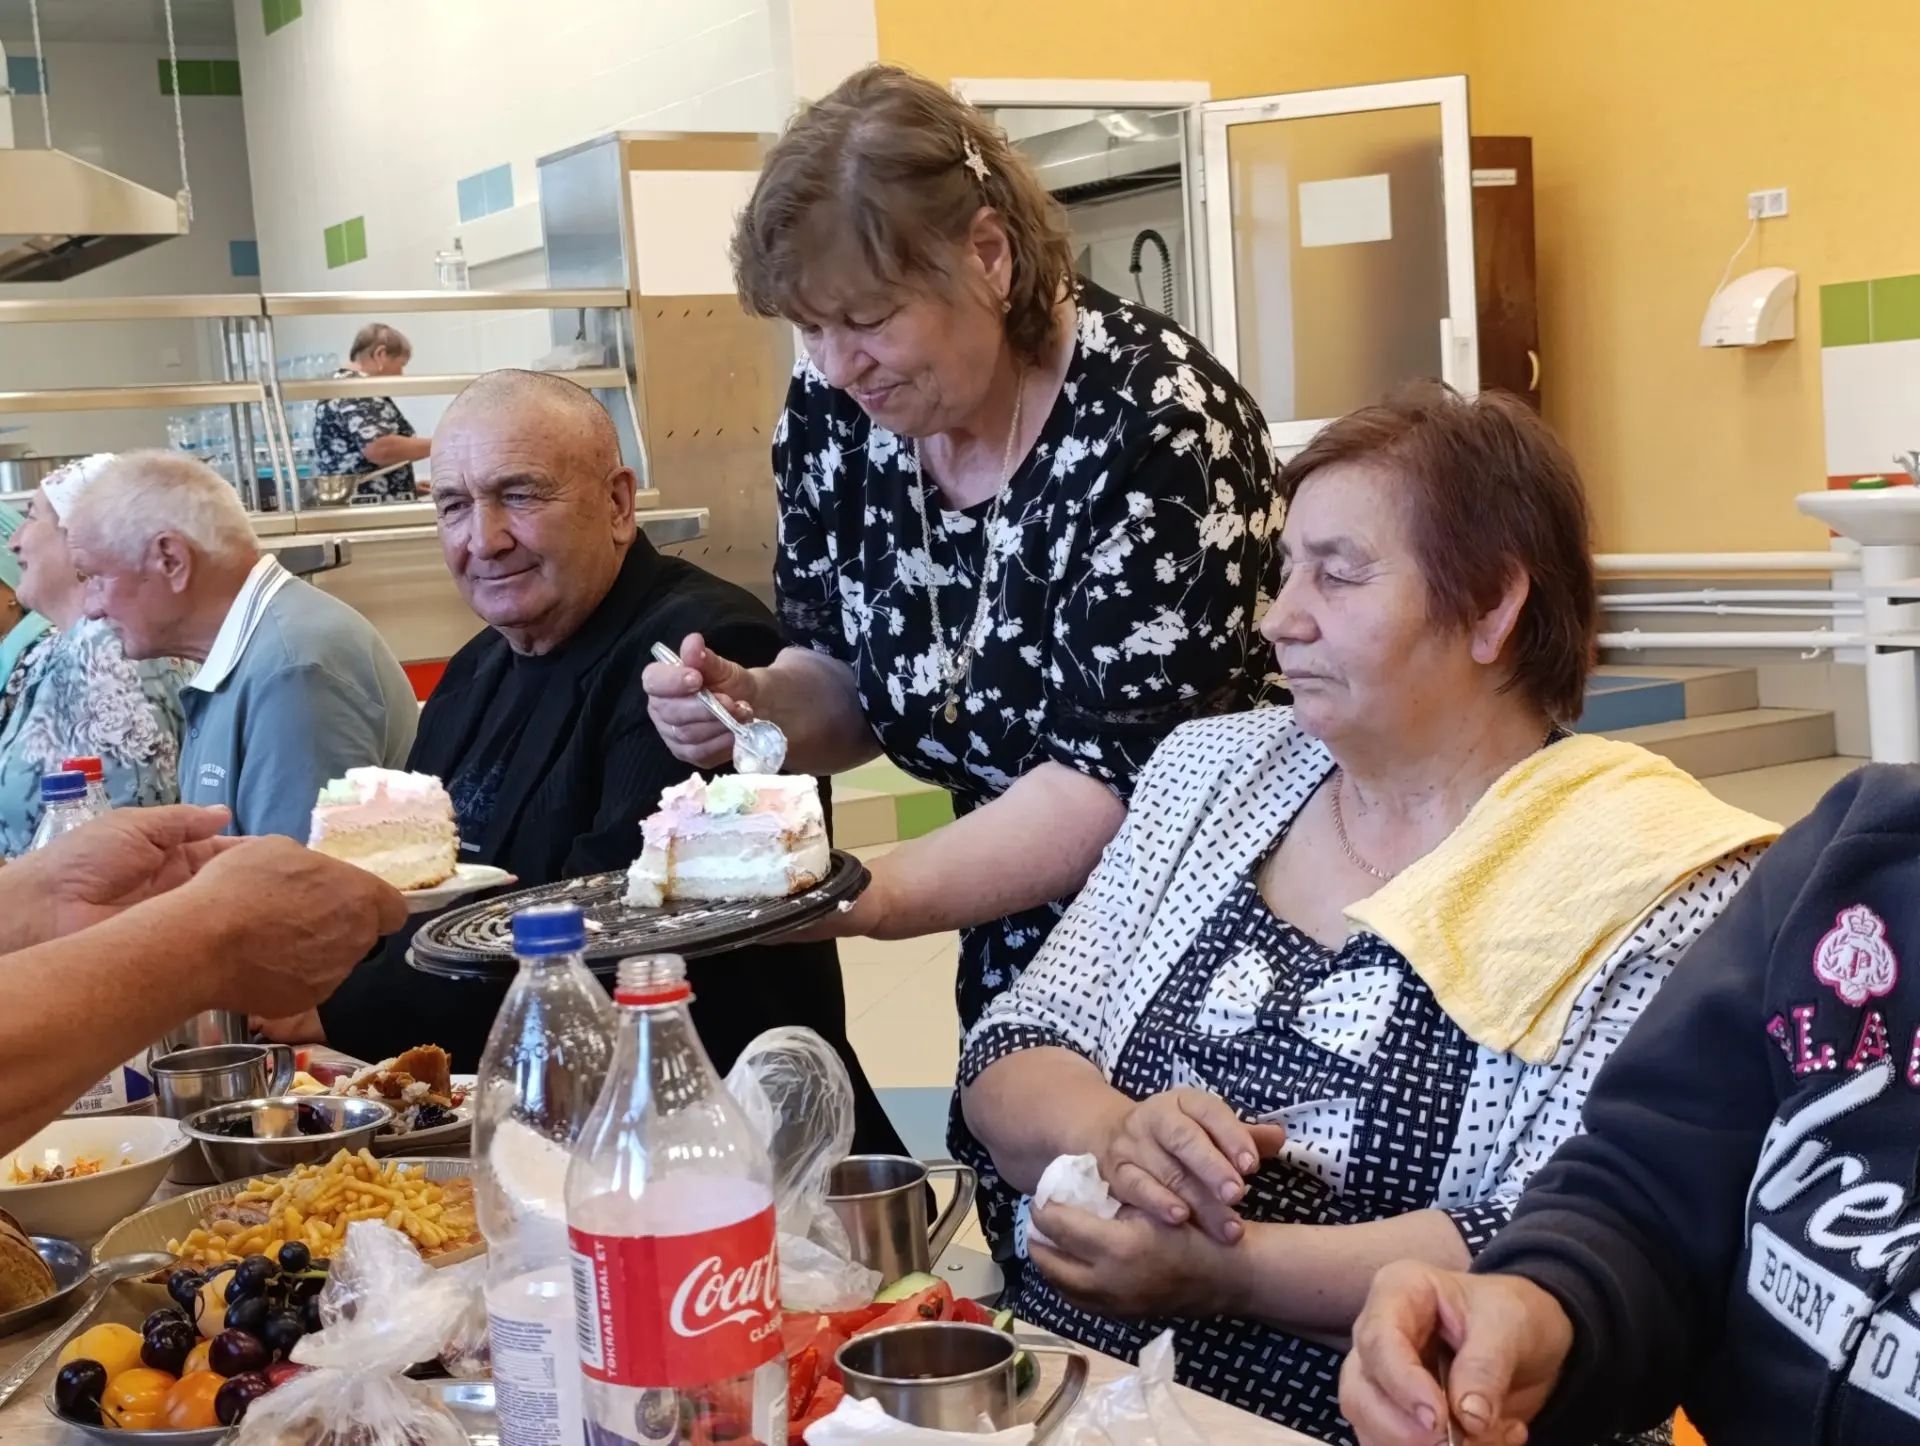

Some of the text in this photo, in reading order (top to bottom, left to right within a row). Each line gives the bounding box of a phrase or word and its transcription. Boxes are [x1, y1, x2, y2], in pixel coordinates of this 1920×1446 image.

[594, 1240, 606, 1261] ET
[599, 1266, 611, 1310] EMAL
[1760, 1248, 1836, 1335] BORN
